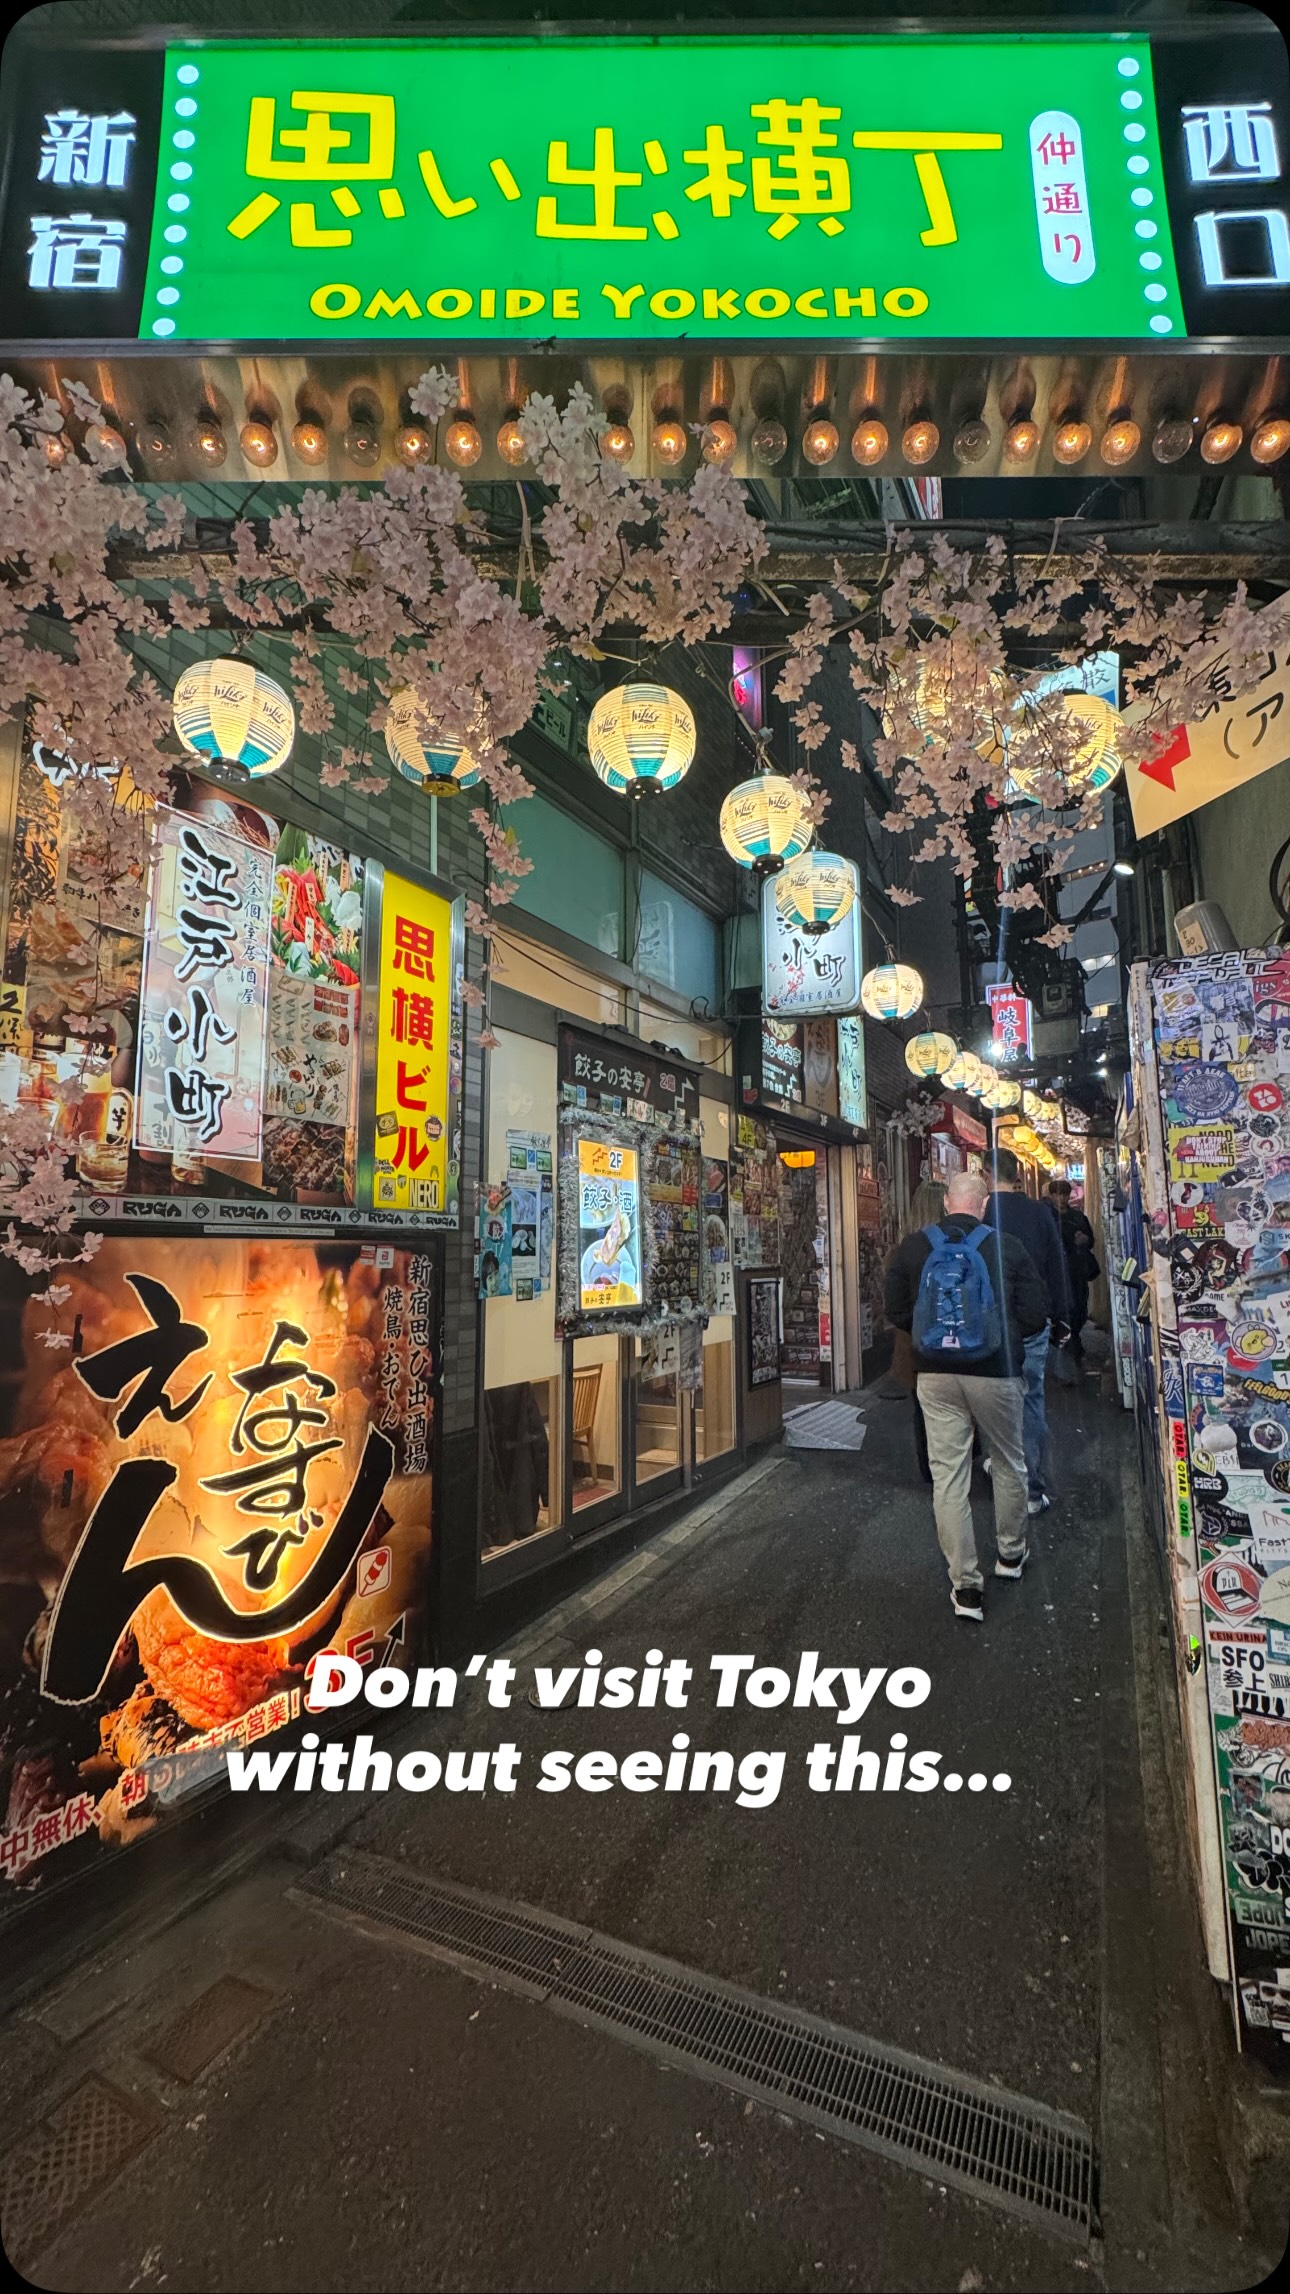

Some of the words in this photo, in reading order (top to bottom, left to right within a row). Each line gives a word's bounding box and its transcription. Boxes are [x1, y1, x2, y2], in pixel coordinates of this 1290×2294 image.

[27, 108, 138, 291] 新宿
[229, 91, 1002, 247] 思い出横丁
[1036, 131, 1083, 264] 仲通り
[1181, 101, 1290, 287] 西口
[310, 283, 580, 320] OMOIDE
[602, 283, 929, 319] YOKOCHO
[164, 824, 243, 1144] 江戸小町
[240, 857, 263, 1006] 完全個室居酒屋
[391, 914, 436, 1173] 思横ビル
[574, 1053, 646, 1094] 餃子の安亭
[998, 1007, 1020, 1063] 岐阜屋
[410, 1179, 438, 1208] NERO
[609, 1151, 623, 1169] 2F
[380, 1287, 404, 1429] 焼鳥・おでん
[403, 1255, 433, 1474] 新宿思ひ出酒場
[1222, 1645, 1265, 1672] SFO
[1222, 1668, 1266, 1693] 参上
